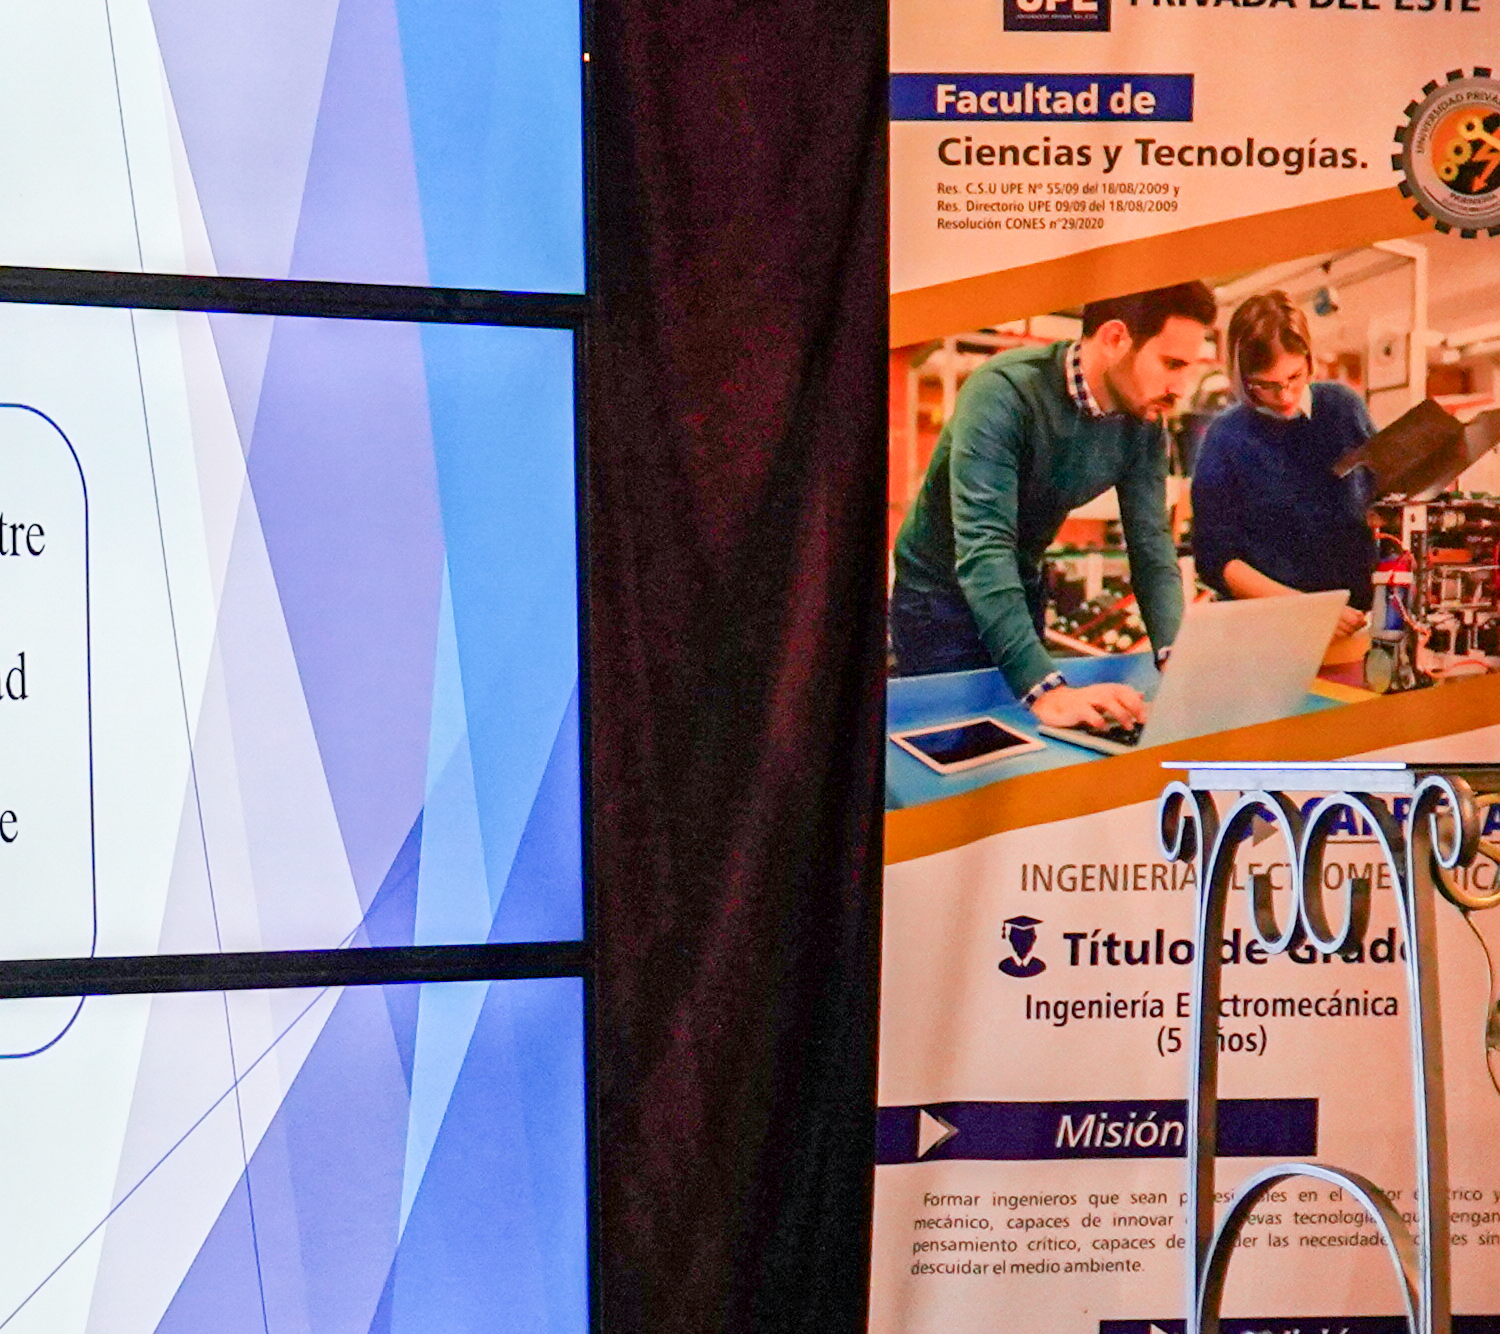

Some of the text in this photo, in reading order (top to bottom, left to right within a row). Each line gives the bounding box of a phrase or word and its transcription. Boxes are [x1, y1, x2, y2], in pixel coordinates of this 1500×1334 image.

[936, 82, 1156, 114] Facultad de
[938, 136, 1368, 175] Ciencias y Tecnologías.
[937, 182, 960, 195] Res.
[1001, 182, 1023, 195] UPE
[1082, 182, 1098, 195] del
[1102, 182, 1169, 196] 18/08/2009
[1174, 186, 1180, 197] y
[937, 199, 961, 212] Res.
[966, 199, 1024, 212] Directorio
[1028, 199, 1051, 212] UPE
[1089, 199, 1105, 212] del
[1109, 199, 1178, 213] 18/08/2009
[937, 217, 1001, 230] Resolución
[1005, 217, 1046, 230] CONES
[1063, 928, 1195, 967] Título
[1025, 989, 1398, 1027] Ingeniería Ectromecánica
[1156, 1024, 1268, 1058] (5 ños)
[1055, 1111, 1185, 1148] Misión
[923, 1193, 980, 1207] Formar
[992, 1191, 1077, 1209] ingenieros
[1088, 1192, 1119, 1210] que
[1130, 1192, 1168, 1205] sean
[1299, 1191, 1318, 1203] en
[1329, 1187, 1343, 1203] el
[914, 1215, 994, 1232] mecánico,
[1007, 1217, 1070, 1232] capaces
[1081, 1213, 1101, 1228] de
[1112, 1213, 1174, 1227] innovar
[912, 1237, 1018, 1255] pensamiento
[1027, 1236, 1082, 1252] crítico,
[1092, 1236, 1156, 1252] capaces
[1166, 1234, 1186, 1249] de
[1268, 1233, 1290, 1247] las
[1300, 1230, 1388, 1247] necesidade
[1478, 1231, 1500, 1246] sin
[910, 1259, 1145, 1276] descuidar el medio ambiente.
